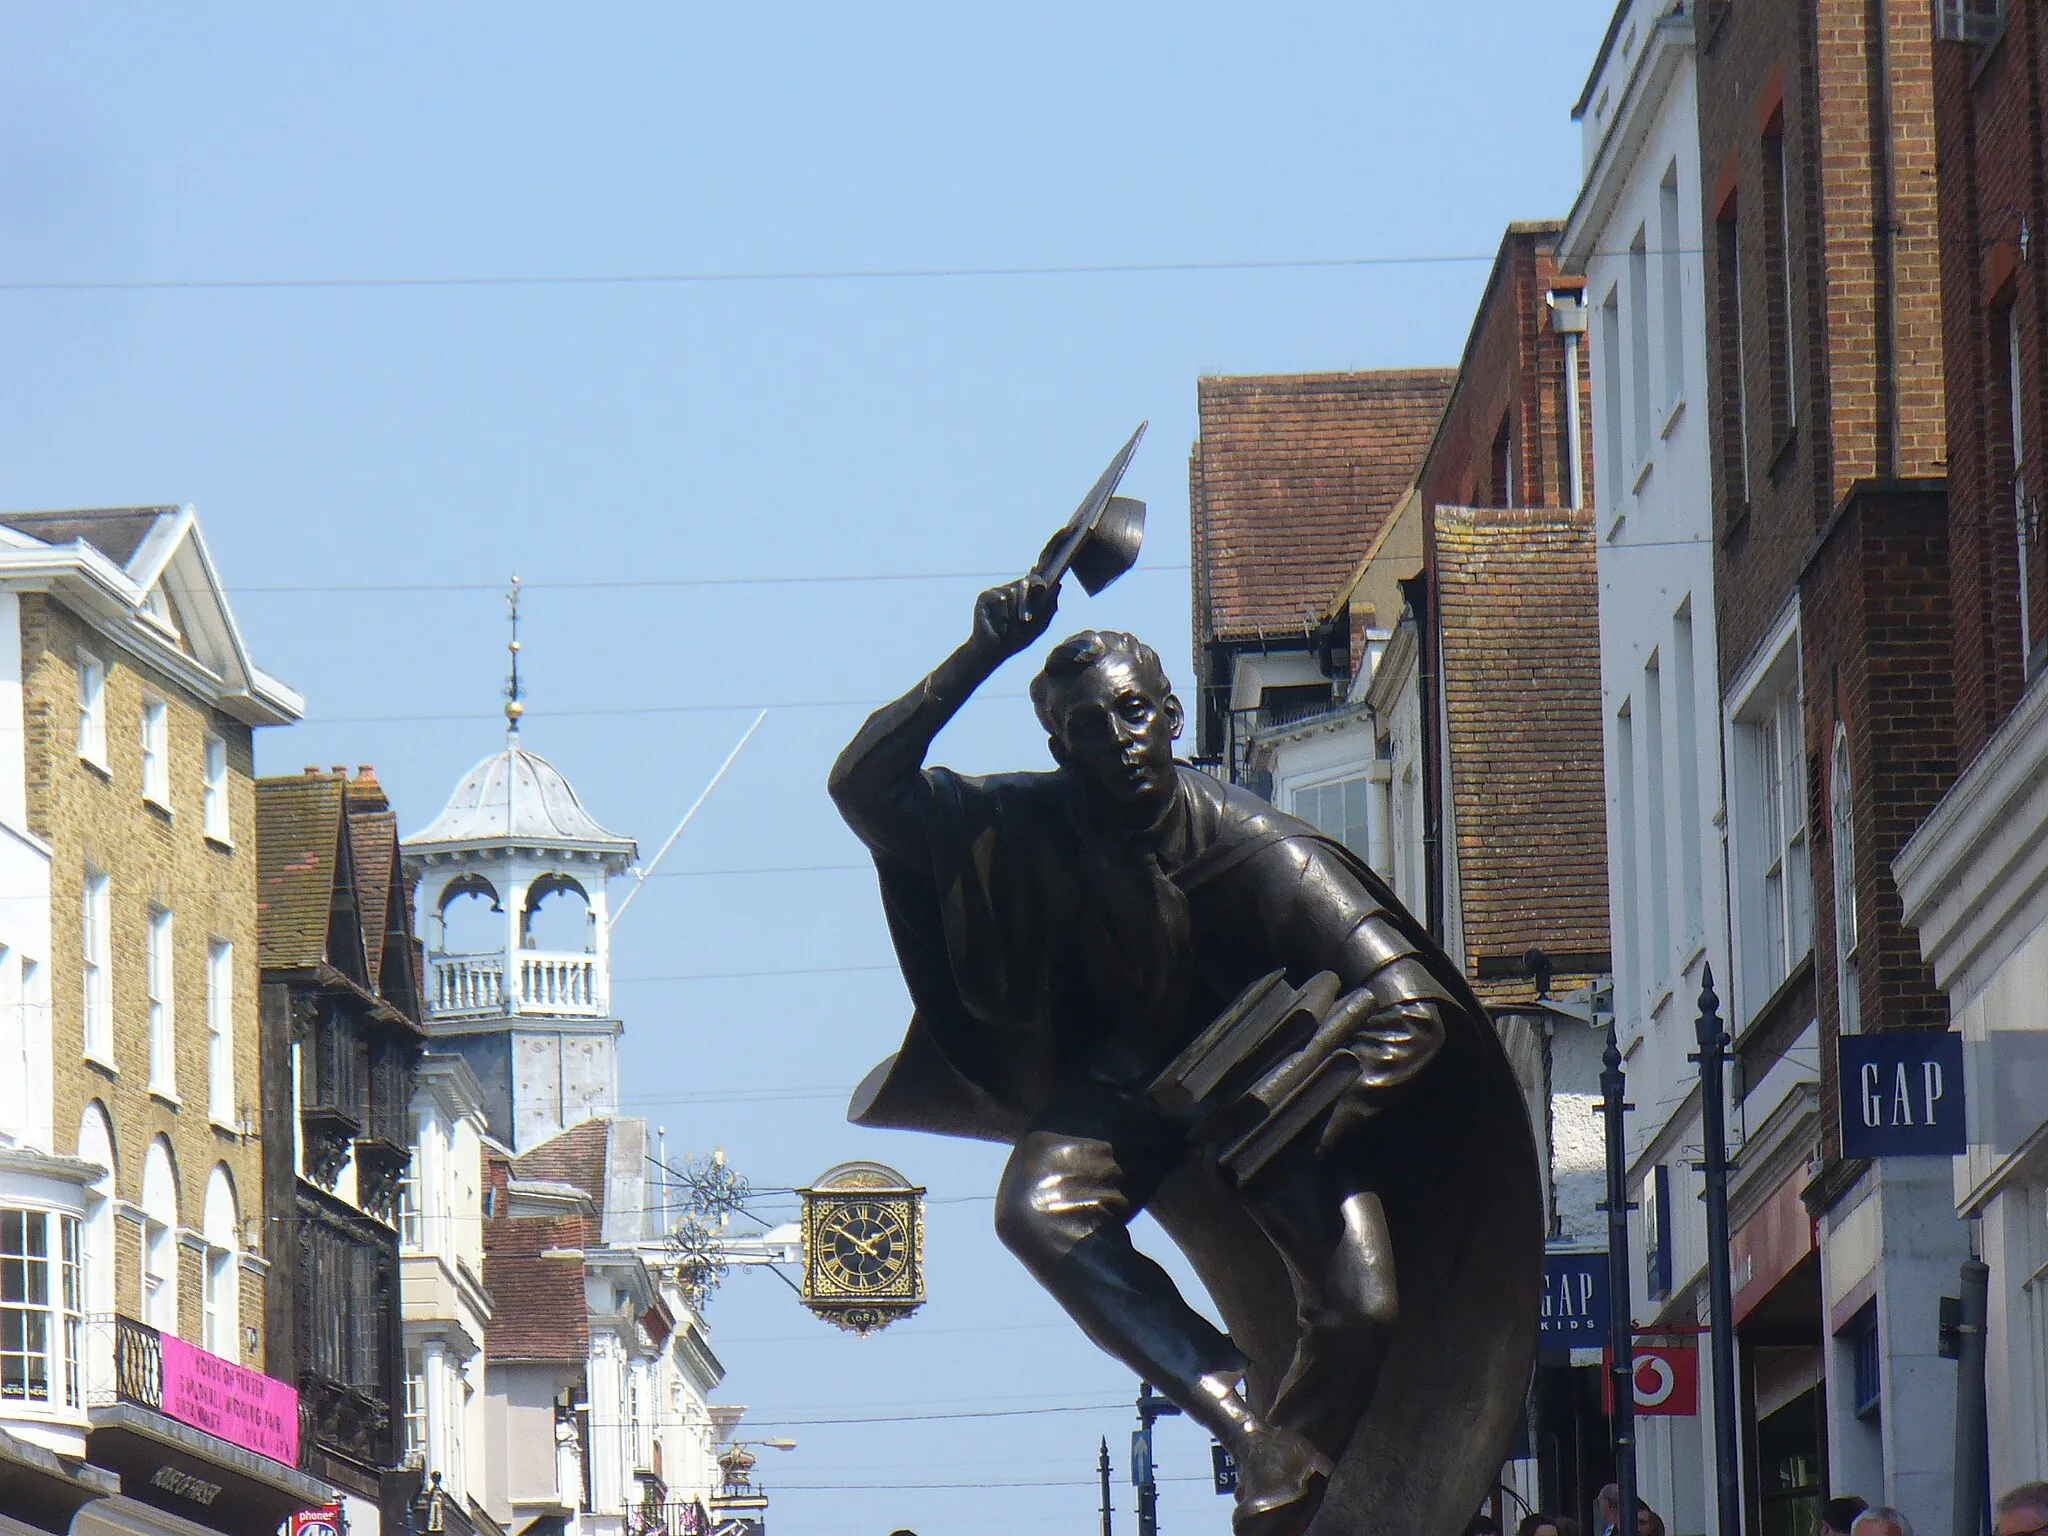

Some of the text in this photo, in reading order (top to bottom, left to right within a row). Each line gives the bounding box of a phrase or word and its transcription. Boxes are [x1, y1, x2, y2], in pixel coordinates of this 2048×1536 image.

[1861, 1061, 1944, 1128] GAP
[1541, 1273, 1593, 1317] GAP
[1540, 1319, 1595, 1331] KIDS
